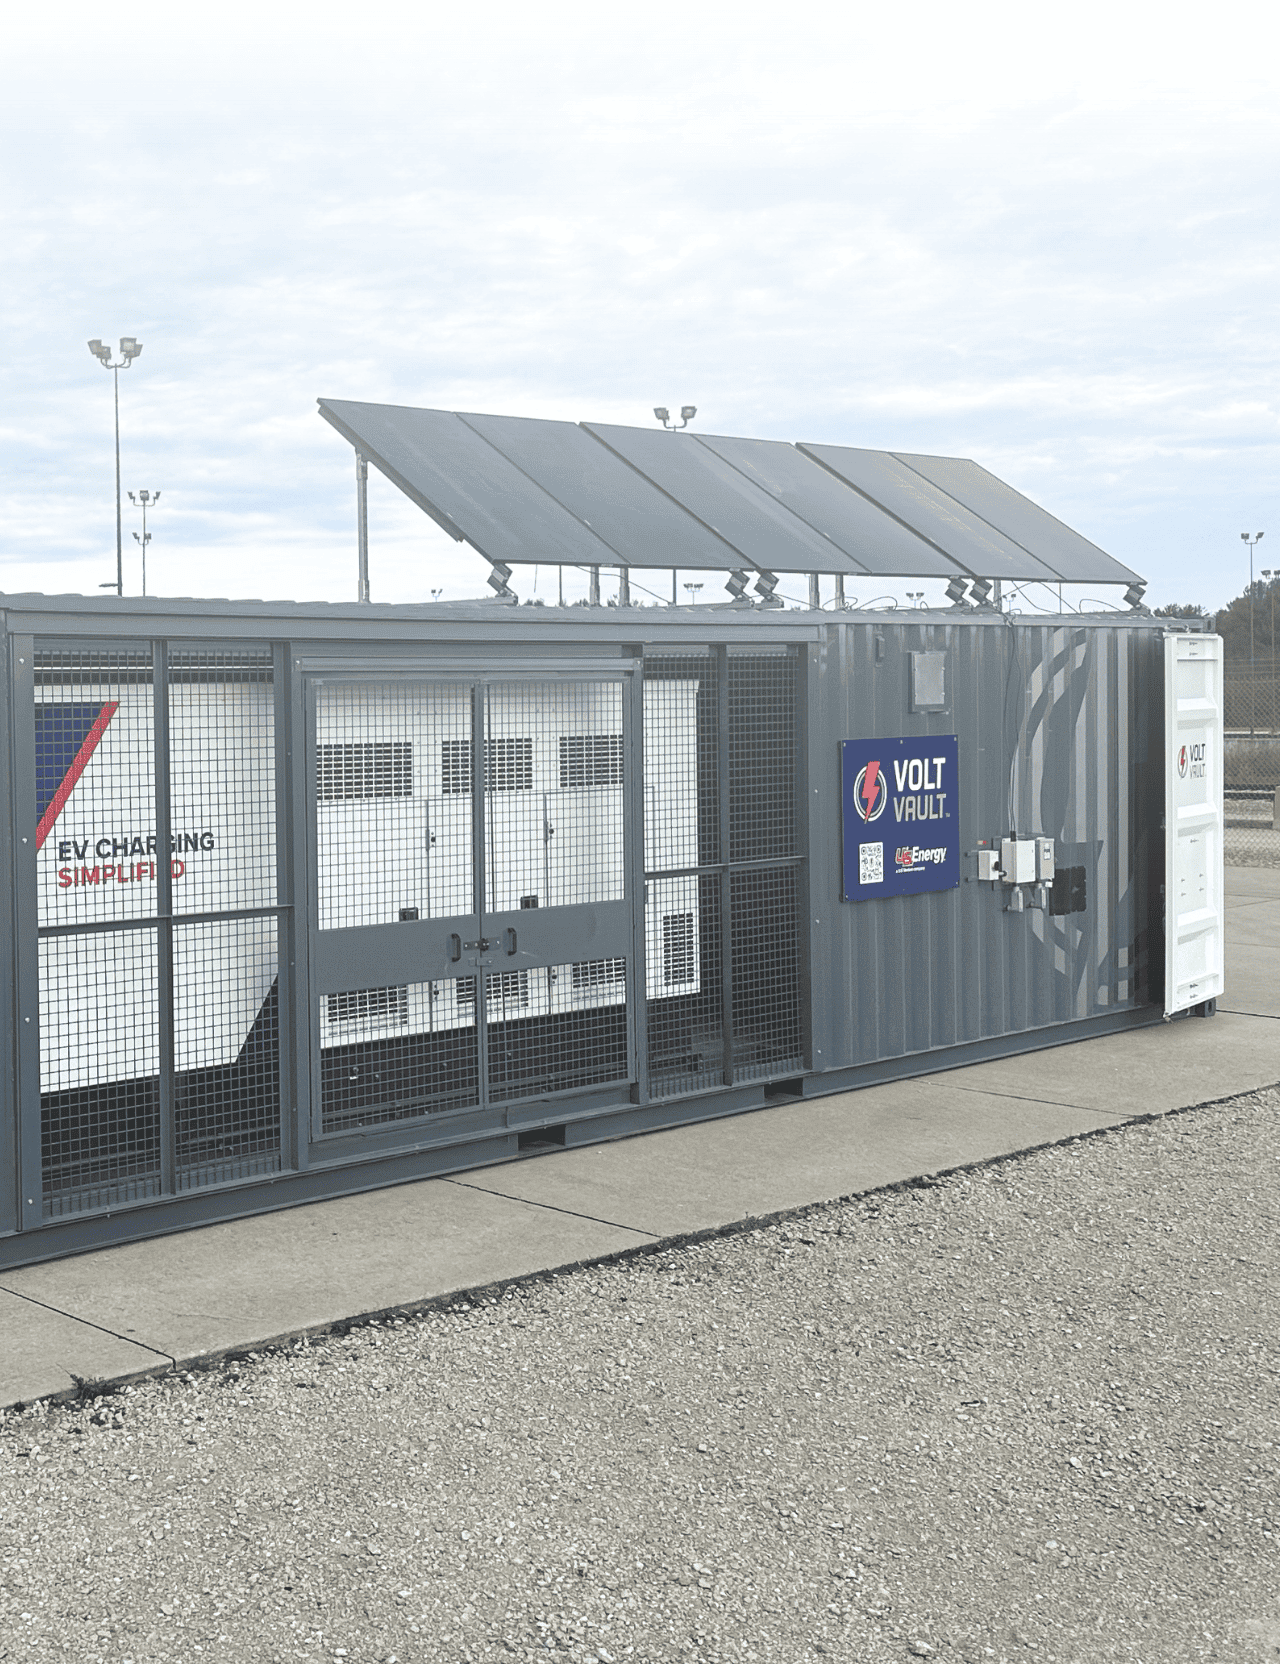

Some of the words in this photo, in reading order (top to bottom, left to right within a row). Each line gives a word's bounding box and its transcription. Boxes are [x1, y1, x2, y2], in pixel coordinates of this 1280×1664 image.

[1189, 743, 1206, 762] VOLT
[893, 757, 946, 792] VOLT
[893, 793, 947, 823] VAULT
[58, 840, 89, 862] EV
[911, 846, 947, 864] Energy
[58, 859, 186, 888] SIMPLIFID
